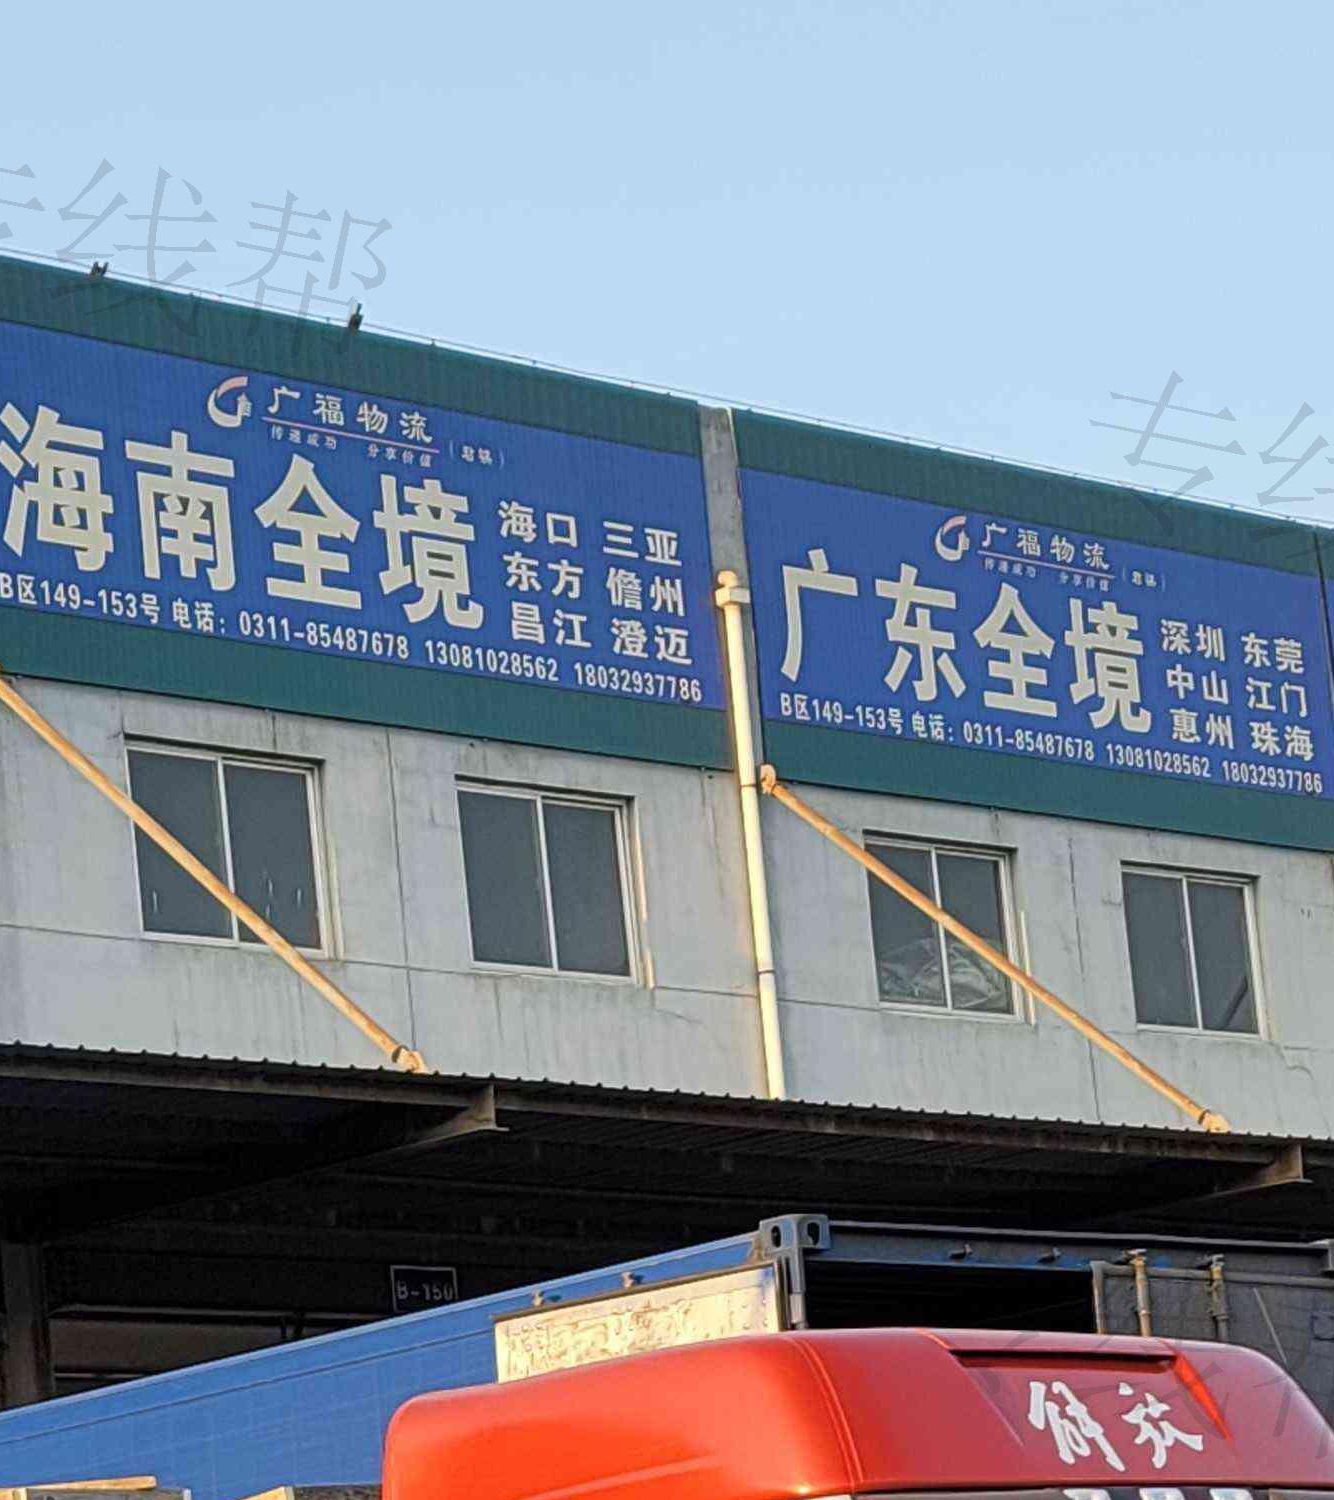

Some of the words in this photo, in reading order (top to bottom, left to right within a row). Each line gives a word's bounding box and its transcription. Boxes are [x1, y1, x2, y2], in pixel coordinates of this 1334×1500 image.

[267, 386, 433, 444] 广福物流
[498, 500, 579, 550] 海口
[602, 521, 681, 568] 三亚
[982, 522, 1109, 570] 广福物流
[503, 551, 584, 600] 东方
[606, 566, 686, 617] 儋州
[238, 612, 410, 661] 0311-85487678
[424, 640, 560, 683] 13081028562
[573, 661, 703, 704] 18032937786
[509, 602, 592, 651] 昌江
[611, 618, 694, 667] 澄迈
[780, 548, 1151, 733] 广东全境
[1160, 619, 1226, 662] 深圳
[1240, 632, 1306, 675] 东莞
[1166, 663, 1228, 705] 中山
[1245, 679, 1308, 718] 江门
[780, 693, 903, 735] B区149-153号
[963, 721, 1094, 763] 0311-85487678
[1106, 744, 1211, 779] 13081028562
[1221, 761, 1322, 796] 18032937786
[1169, 708, 1235, 750] 惠州
[1249, 721, 1314, 761] 珠海
